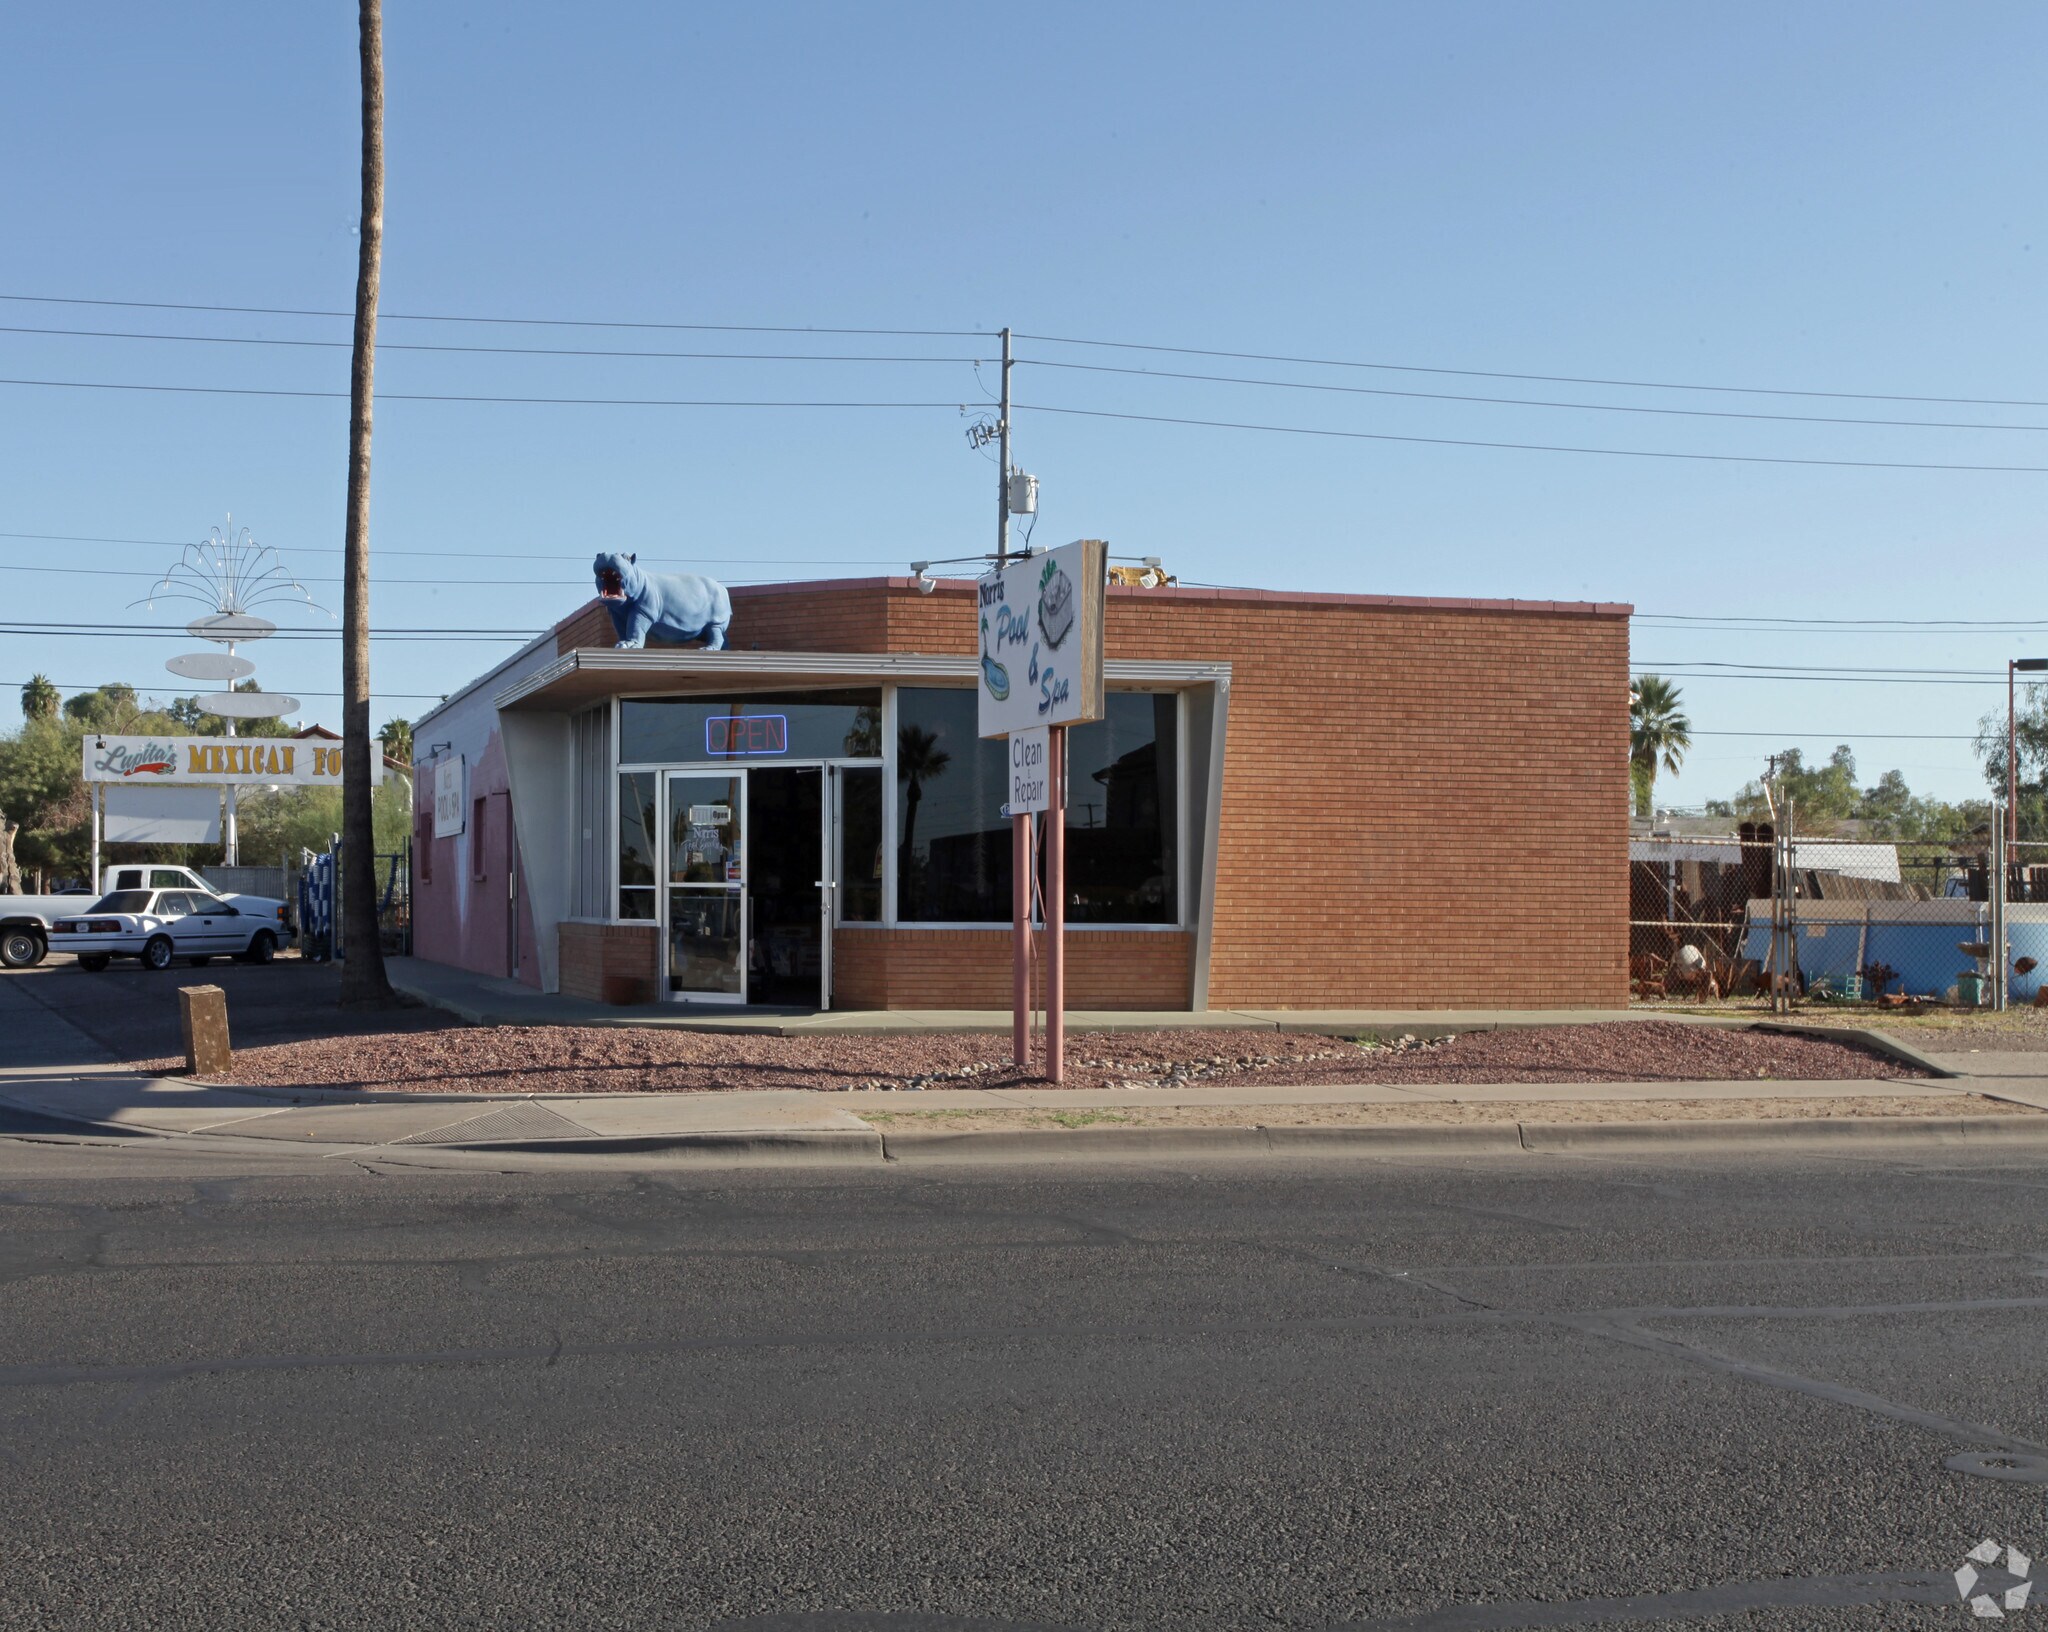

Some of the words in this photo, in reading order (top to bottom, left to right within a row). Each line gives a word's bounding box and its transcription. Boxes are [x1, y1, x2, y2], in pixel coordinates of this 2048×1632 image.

[979, 572, 1005, 609] Norris
[996, 604, 1031, 655] Pool
[1028, 641, 1039, 686] &
[1038, 666, 1070, 717] Spa
[709, 718, 784, 750] OPEN
[1013, 737, 1042, 768] Clean
[94, 741, 178, 774] Lupita's
[187, 744, 295, 775] MEXICAN
[1014, 775, 1044, 812] Repair
[713, 810, 728, 820] Open
